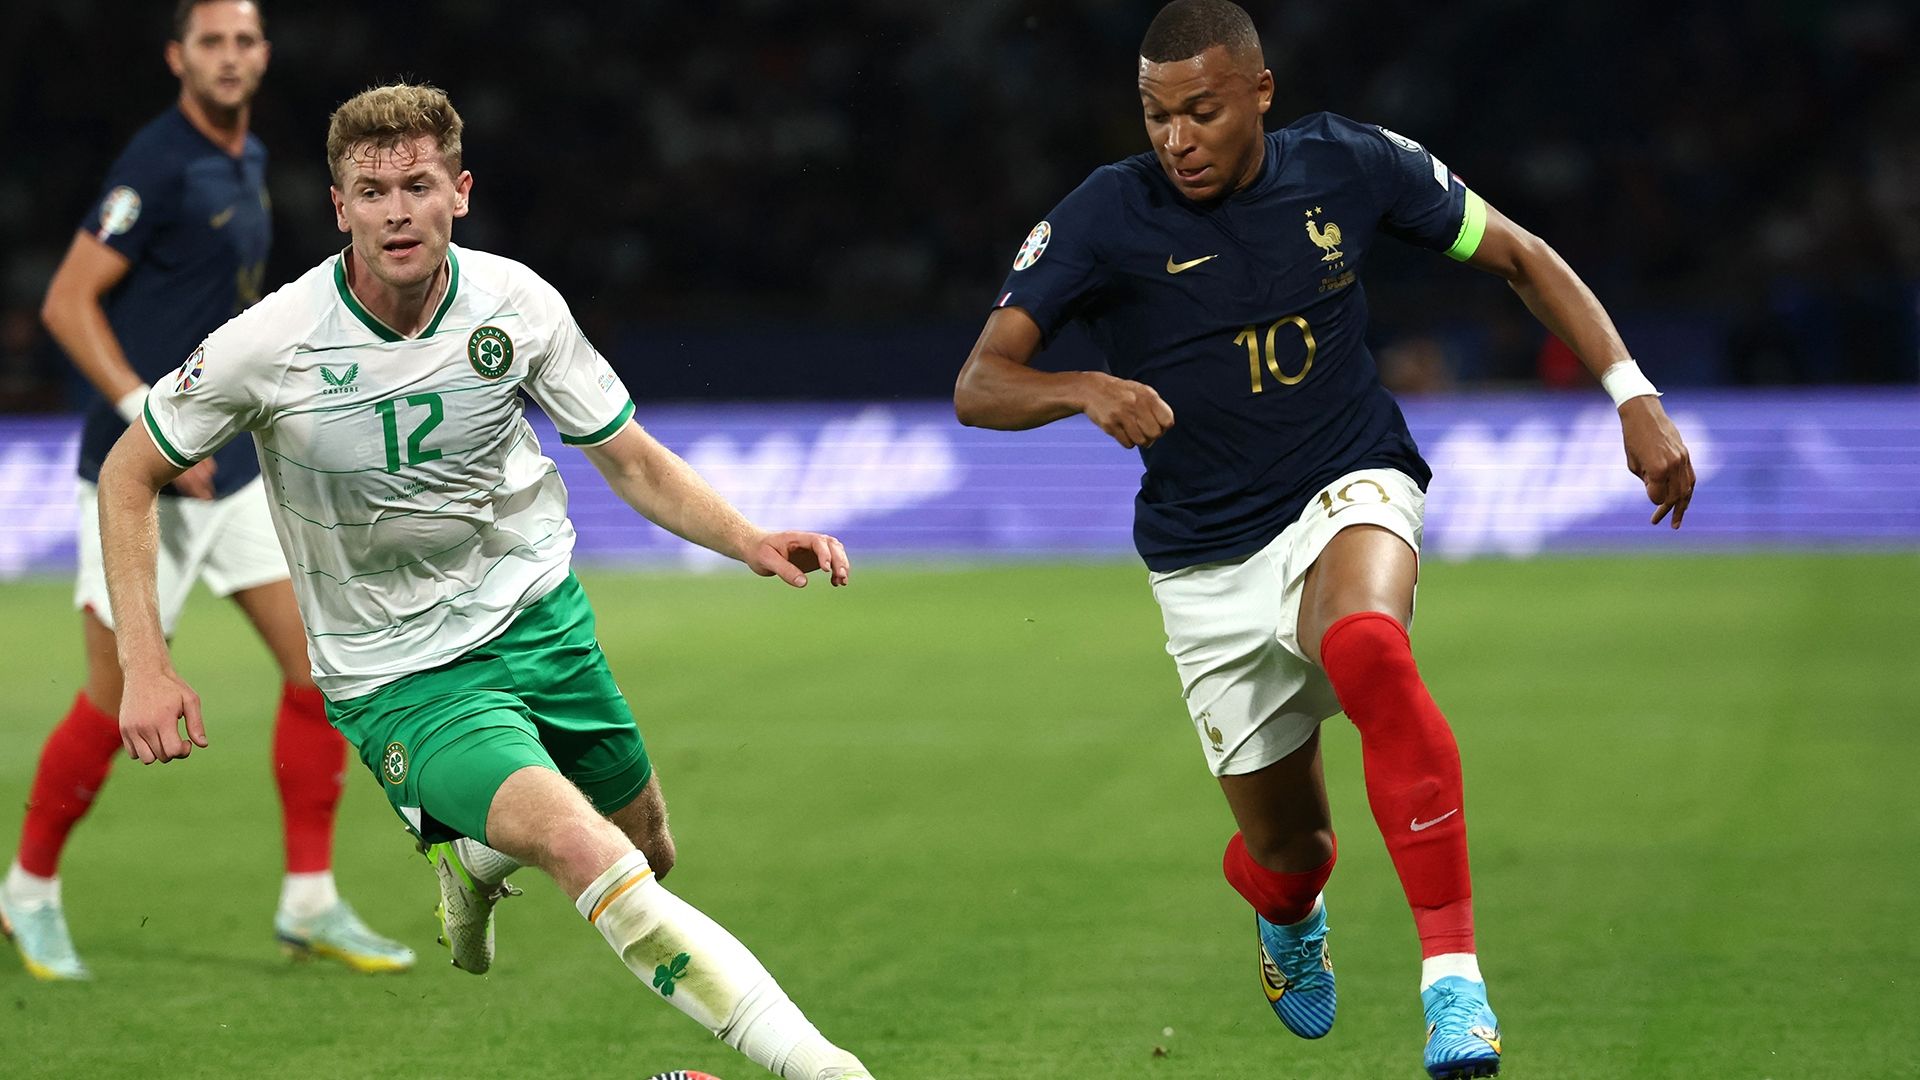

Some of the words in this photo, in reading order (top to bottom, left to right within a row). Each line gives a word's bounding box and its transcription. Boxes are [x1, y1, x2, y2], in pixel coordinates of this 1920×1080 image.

[470, 329, 507, 349] IRELAND
[1232, 315, 1317, 393] 10
[322, 386, 359, 395] CASTORE
[374, 392, 444, 474] 12
